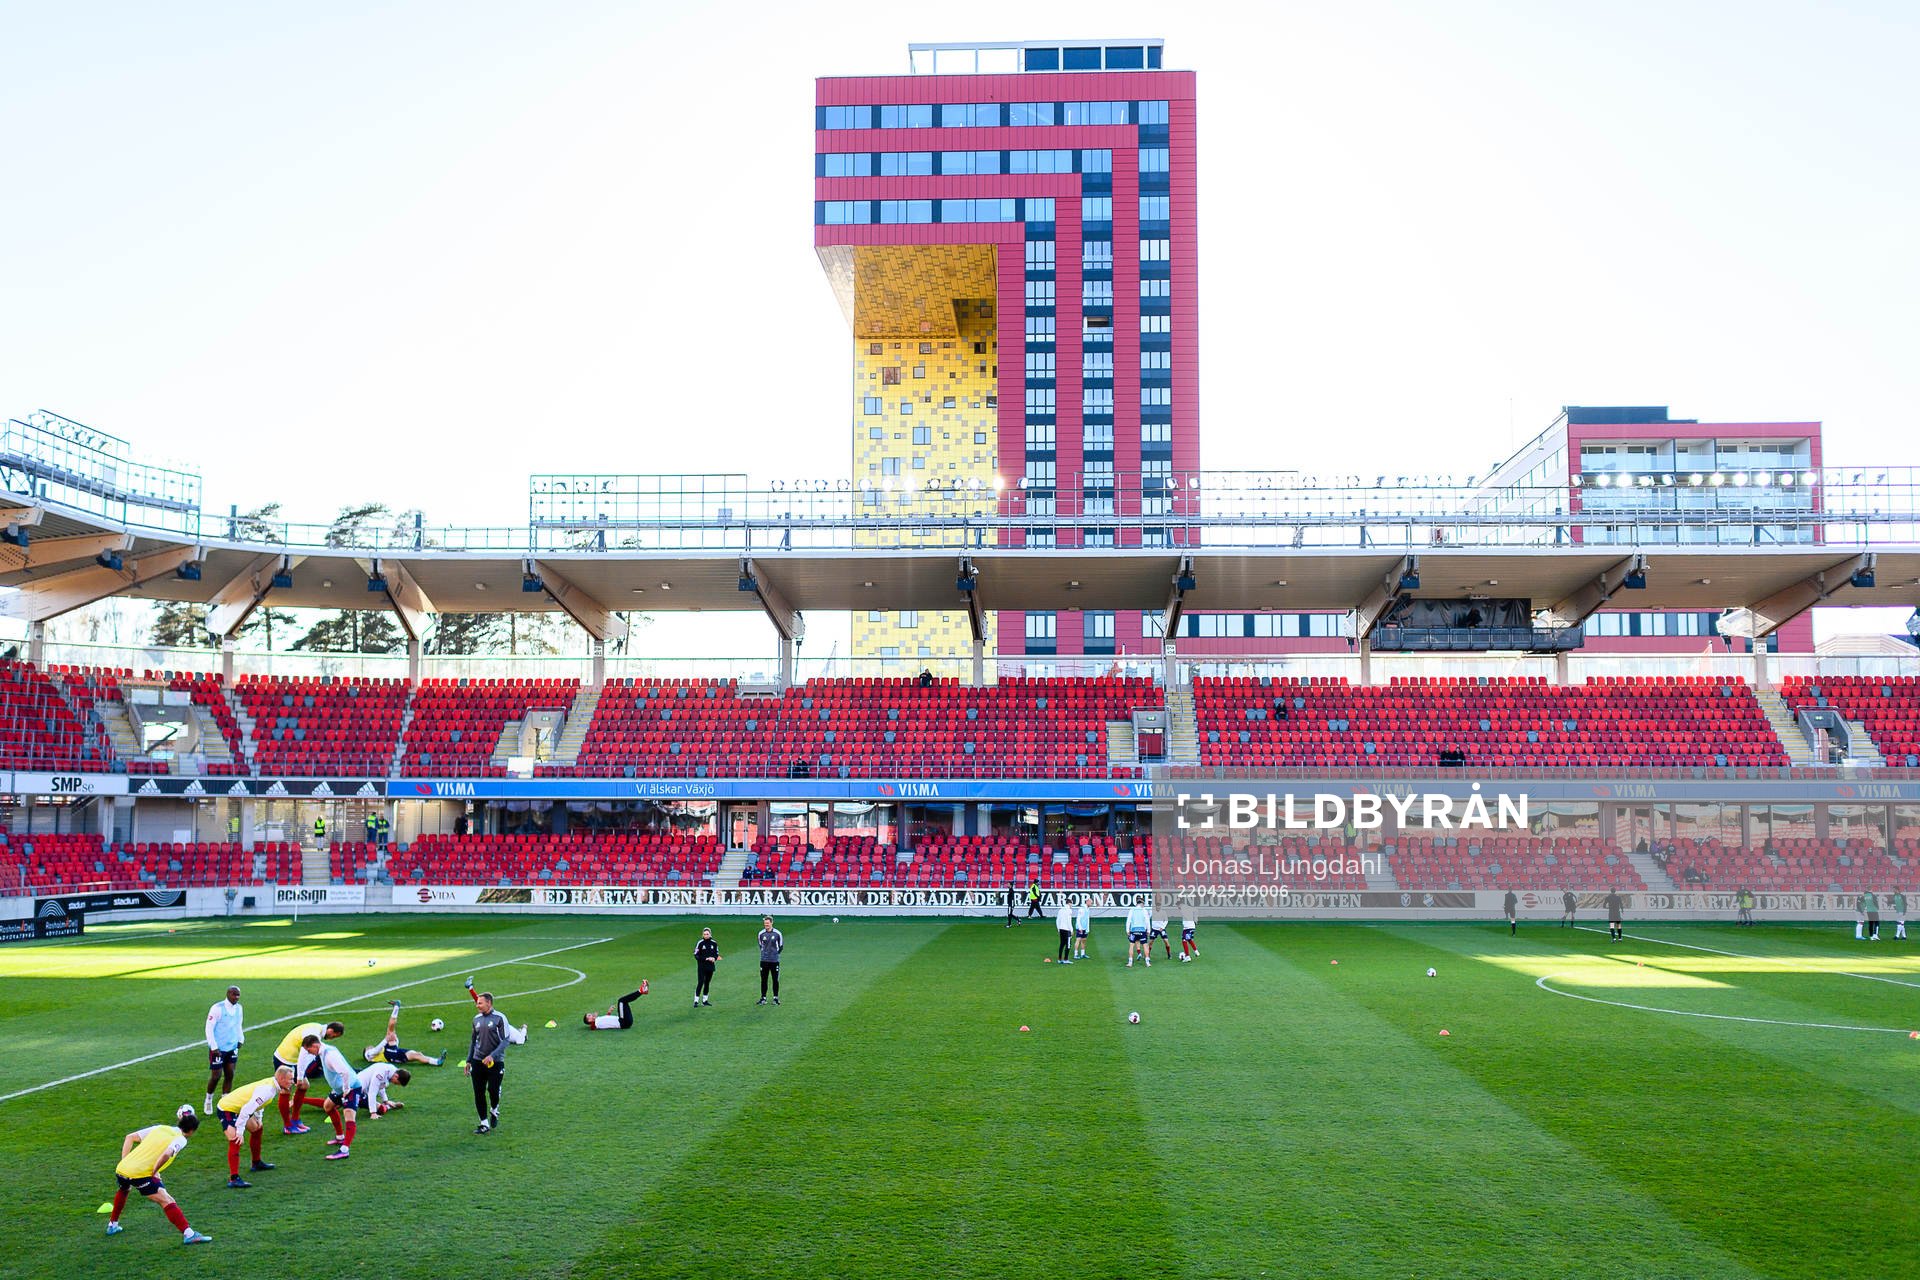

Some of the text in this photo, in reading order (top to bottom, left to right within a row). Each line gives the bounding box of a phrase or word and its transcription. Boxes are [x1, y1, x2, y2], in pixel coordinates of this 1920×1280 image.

[436, 782, 475, 796] VISMA
[636, 783, 715, 797] Vi älskar Växjö
[899, 783, 939, 796] VISMA
[1134, 784, 1175, 796] VISMA
[1373, 783, 1414, 797] VISMA
[1614, 784, 1656, 797] VISMA
[1858, 784, 1901, 797] VISMA
[432, 889, 456, 901] VIDA
[658, 890, 695, 905] DEN
[867, 891, 890, 906] DE
[892, 889, 997, 907] FÖRÄDLADE
[1274, 893, 1362, 908] IDROTTEN
[1537, 895, 1564, 905] VIDA
[1767, 895, 1803, 909] DEN
